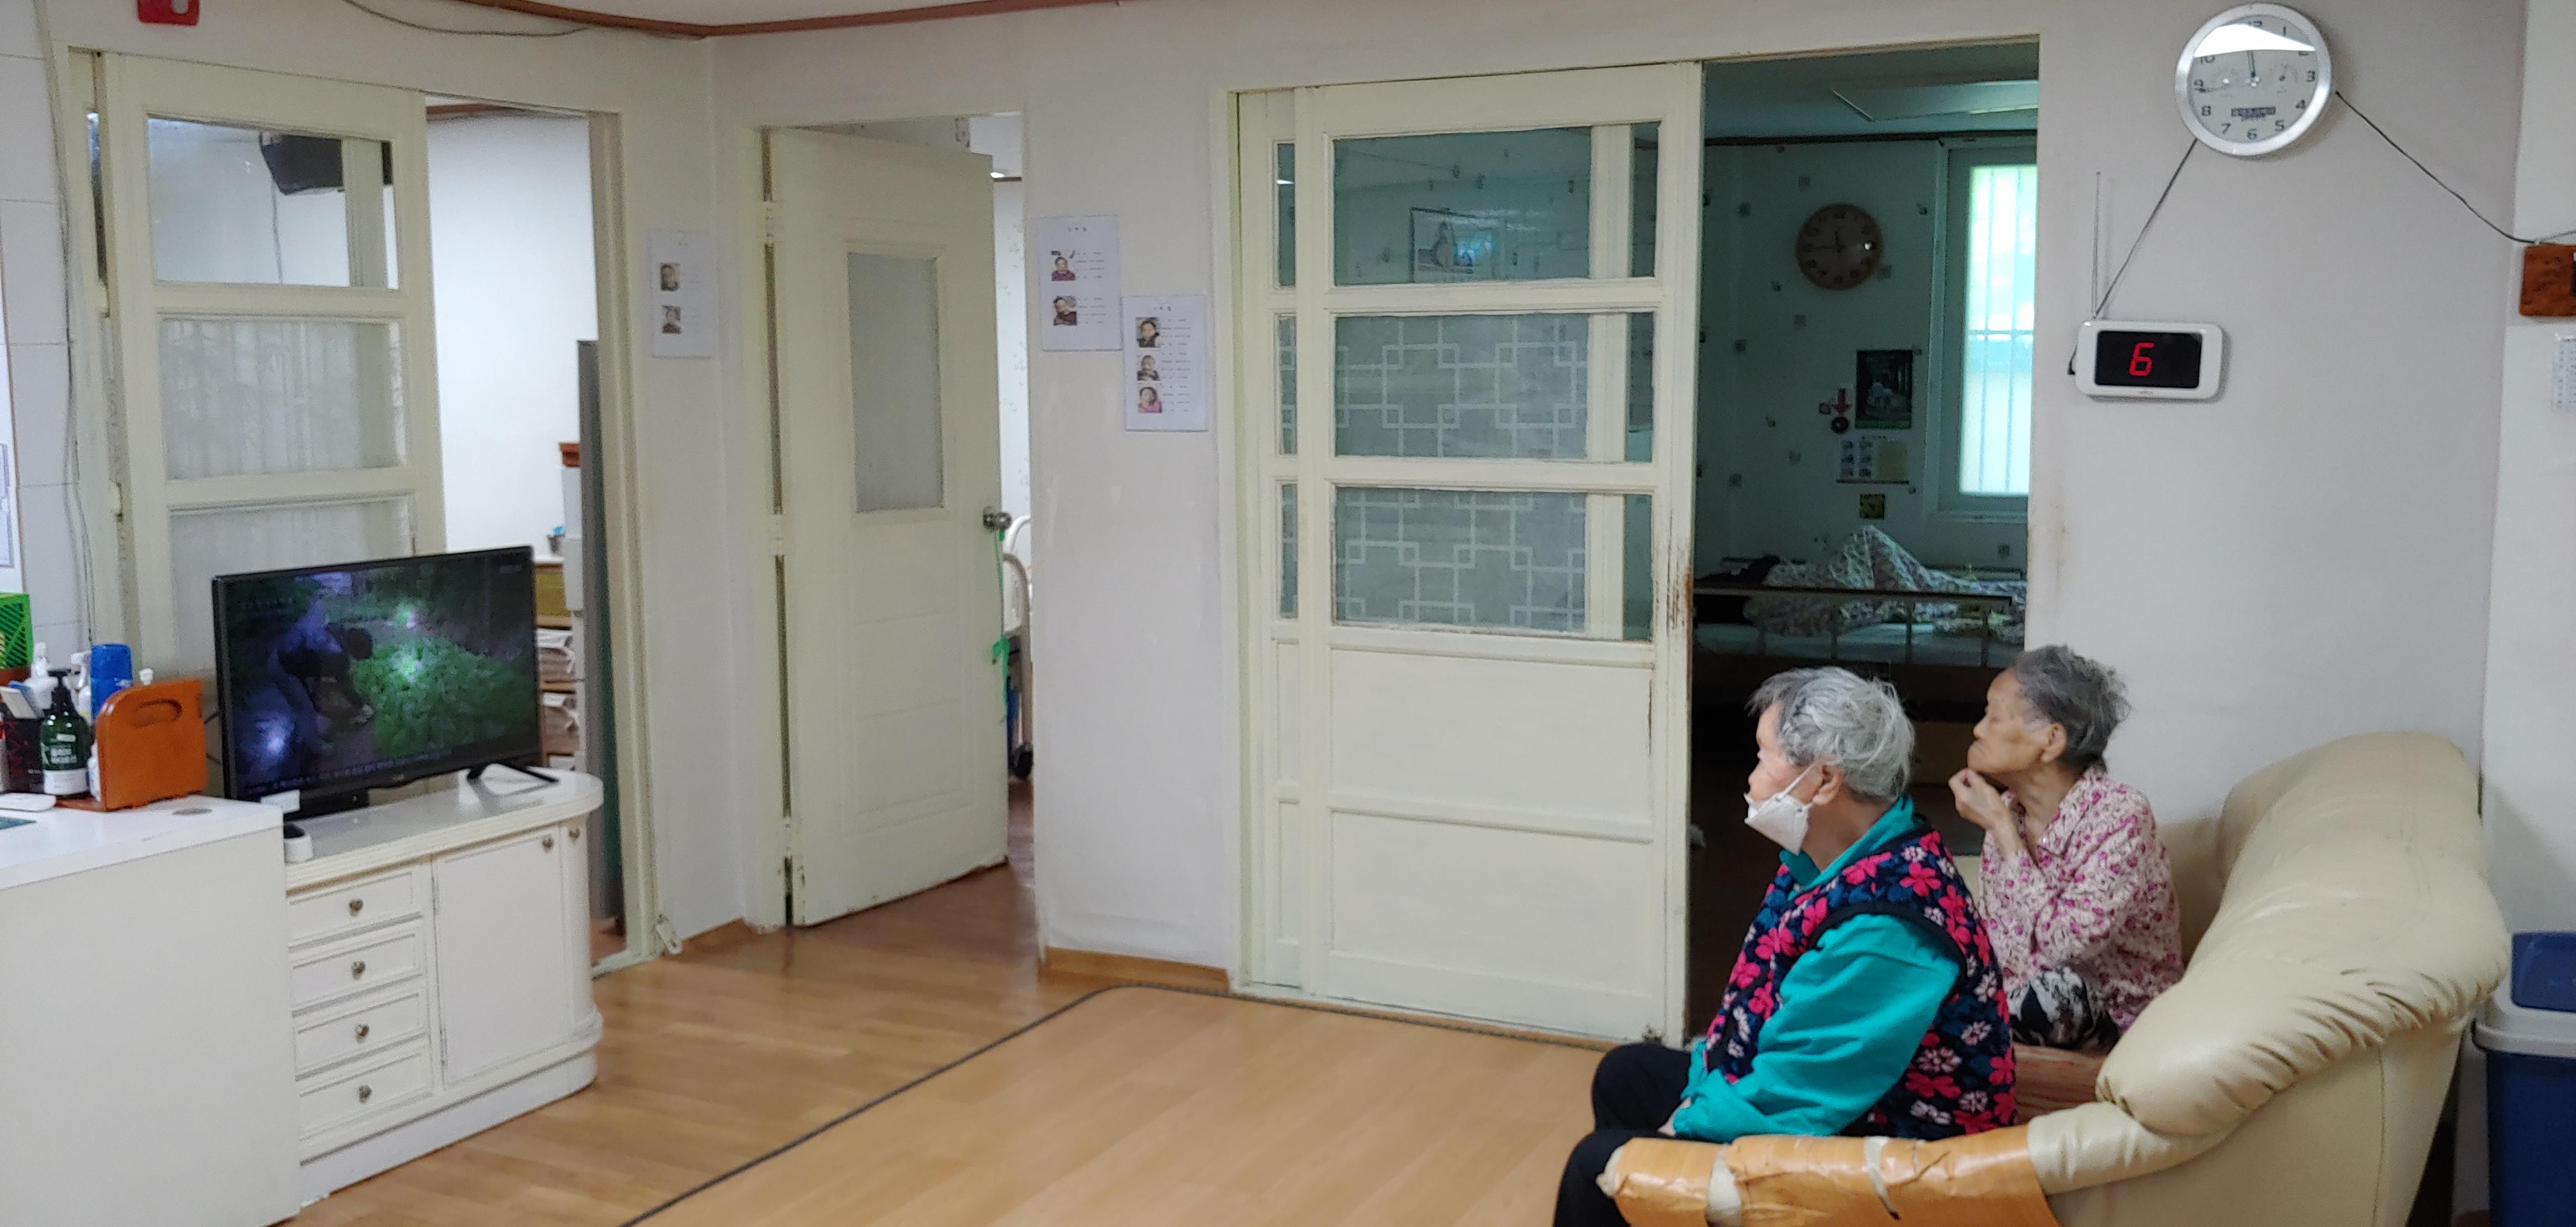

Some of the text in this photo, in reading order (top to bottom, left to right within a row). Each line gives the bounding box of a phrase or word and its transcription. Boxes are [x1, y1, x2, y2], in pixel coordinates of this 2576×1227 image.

[2306, 70, 2315, 82] 3
[2296, 100, 2306, 109] 4
[2201, 106, 2211, 117] 8
[2221, 123, 2231, 134] 7
[2275, 120, 2285, 132] 5
[2247, 128, 2257, 139] 6
[2129, 342, 2155, 377] 6
